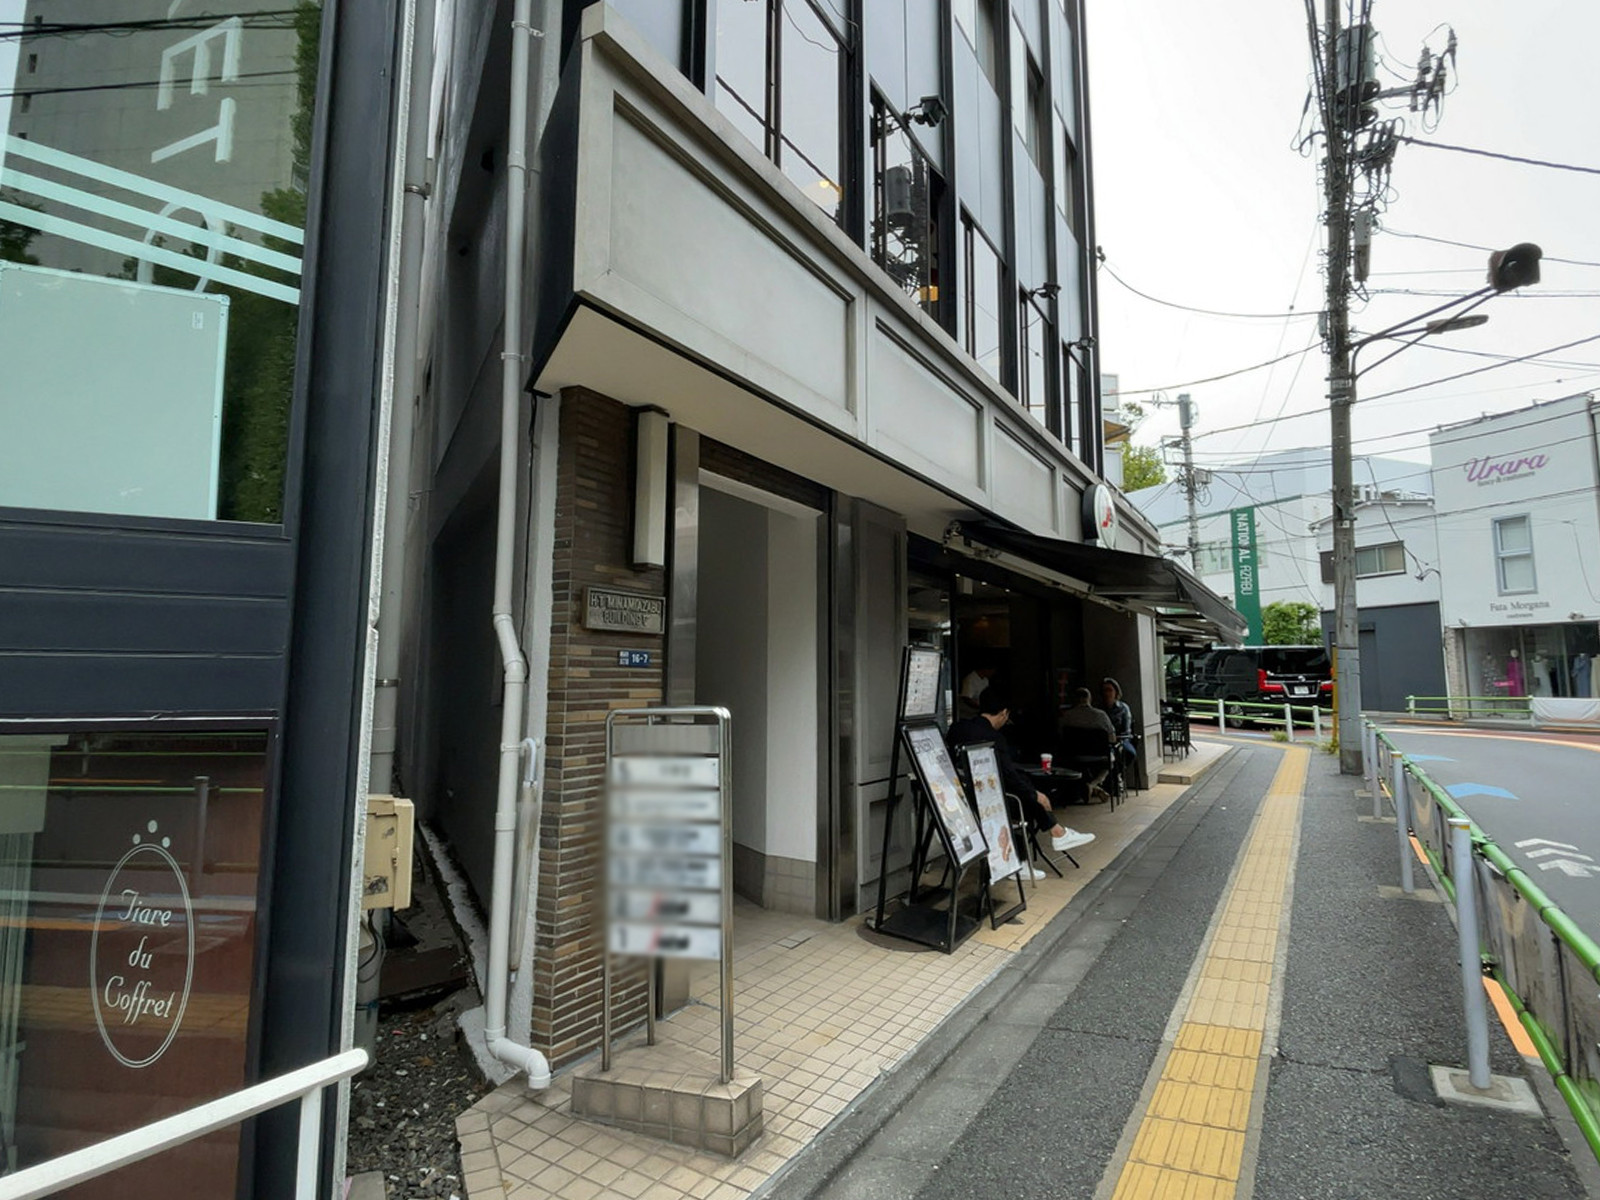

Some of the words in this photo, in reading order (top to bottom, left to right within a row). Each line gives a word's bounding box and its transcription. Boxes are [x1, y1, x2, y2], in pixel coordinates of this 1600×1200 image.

[1464, 455, 1550, 482] Urara
[1236, 512, 1251, 563] NATIONAL
[1239, 564, 1253, 596] AZABU
[118, 889, 172, 927] Tiare
[128, 936, 153, 969] du
[104, 975, 176, 1026] Coffret
